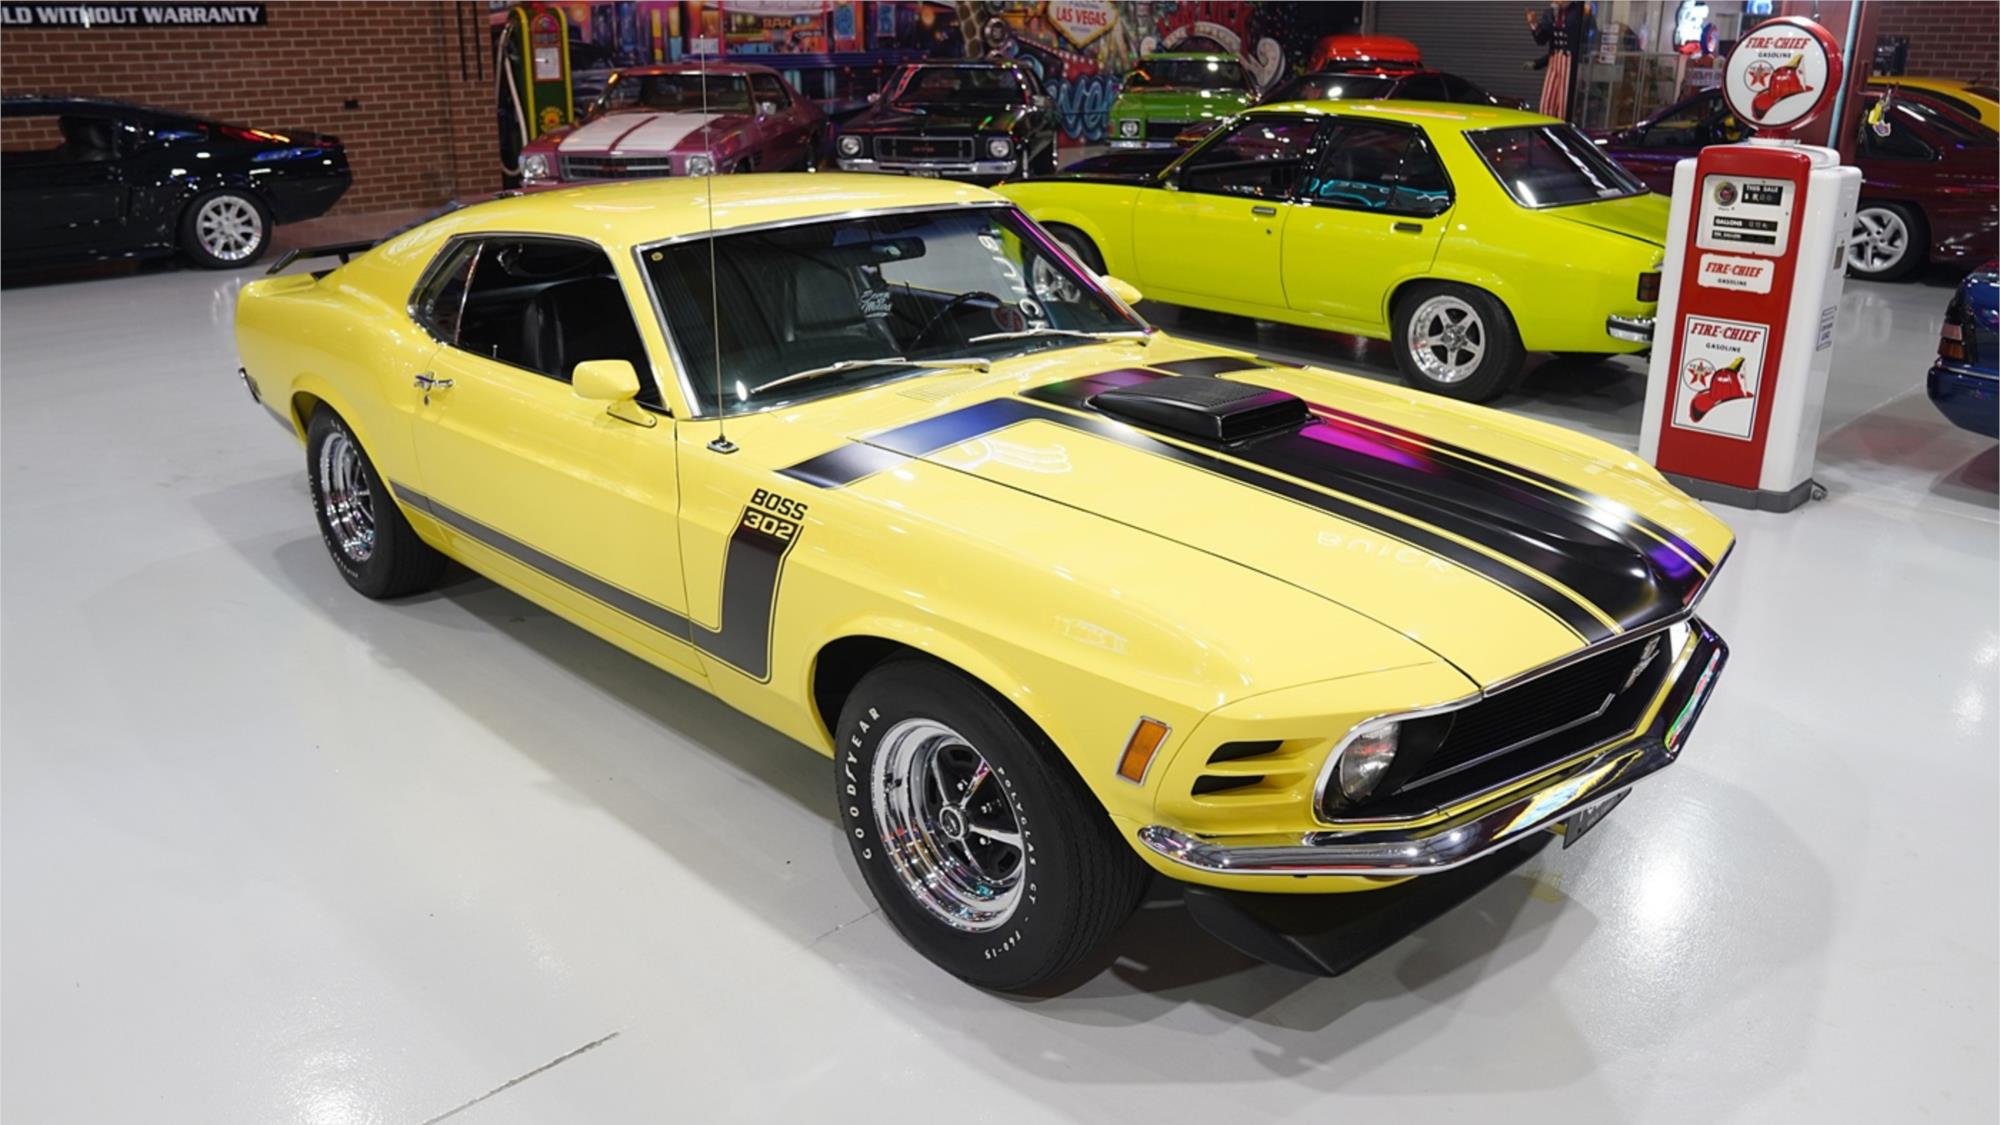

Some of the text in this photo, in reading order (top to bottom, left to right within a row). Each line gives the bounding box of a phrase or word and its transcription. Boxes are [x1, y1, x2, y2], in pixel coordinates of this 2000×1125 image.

[0, 6, 31, 24] LD
[142, 6, 260, 24] WARRANTY
[1056, 7, 1107, 26] LAS VEGAS
[1745, 36, 1811, 49] FIRE-CHIEF
[1705, 262, 1763, 278] FIRE-CHIEF
[1718, 277, 1746, 286] GASOLINE
[1690, 322, 1761, 343] FIRE-CHIEF
[1705, 342, 1741, 353] GASOLINE
[750, 487, 808, 521] BOSS
[743, 510, 795, 541] 302
[844, 706, 881, 860] GOODYEAR
[998, 766, 1037, 866] POLYGLAS
